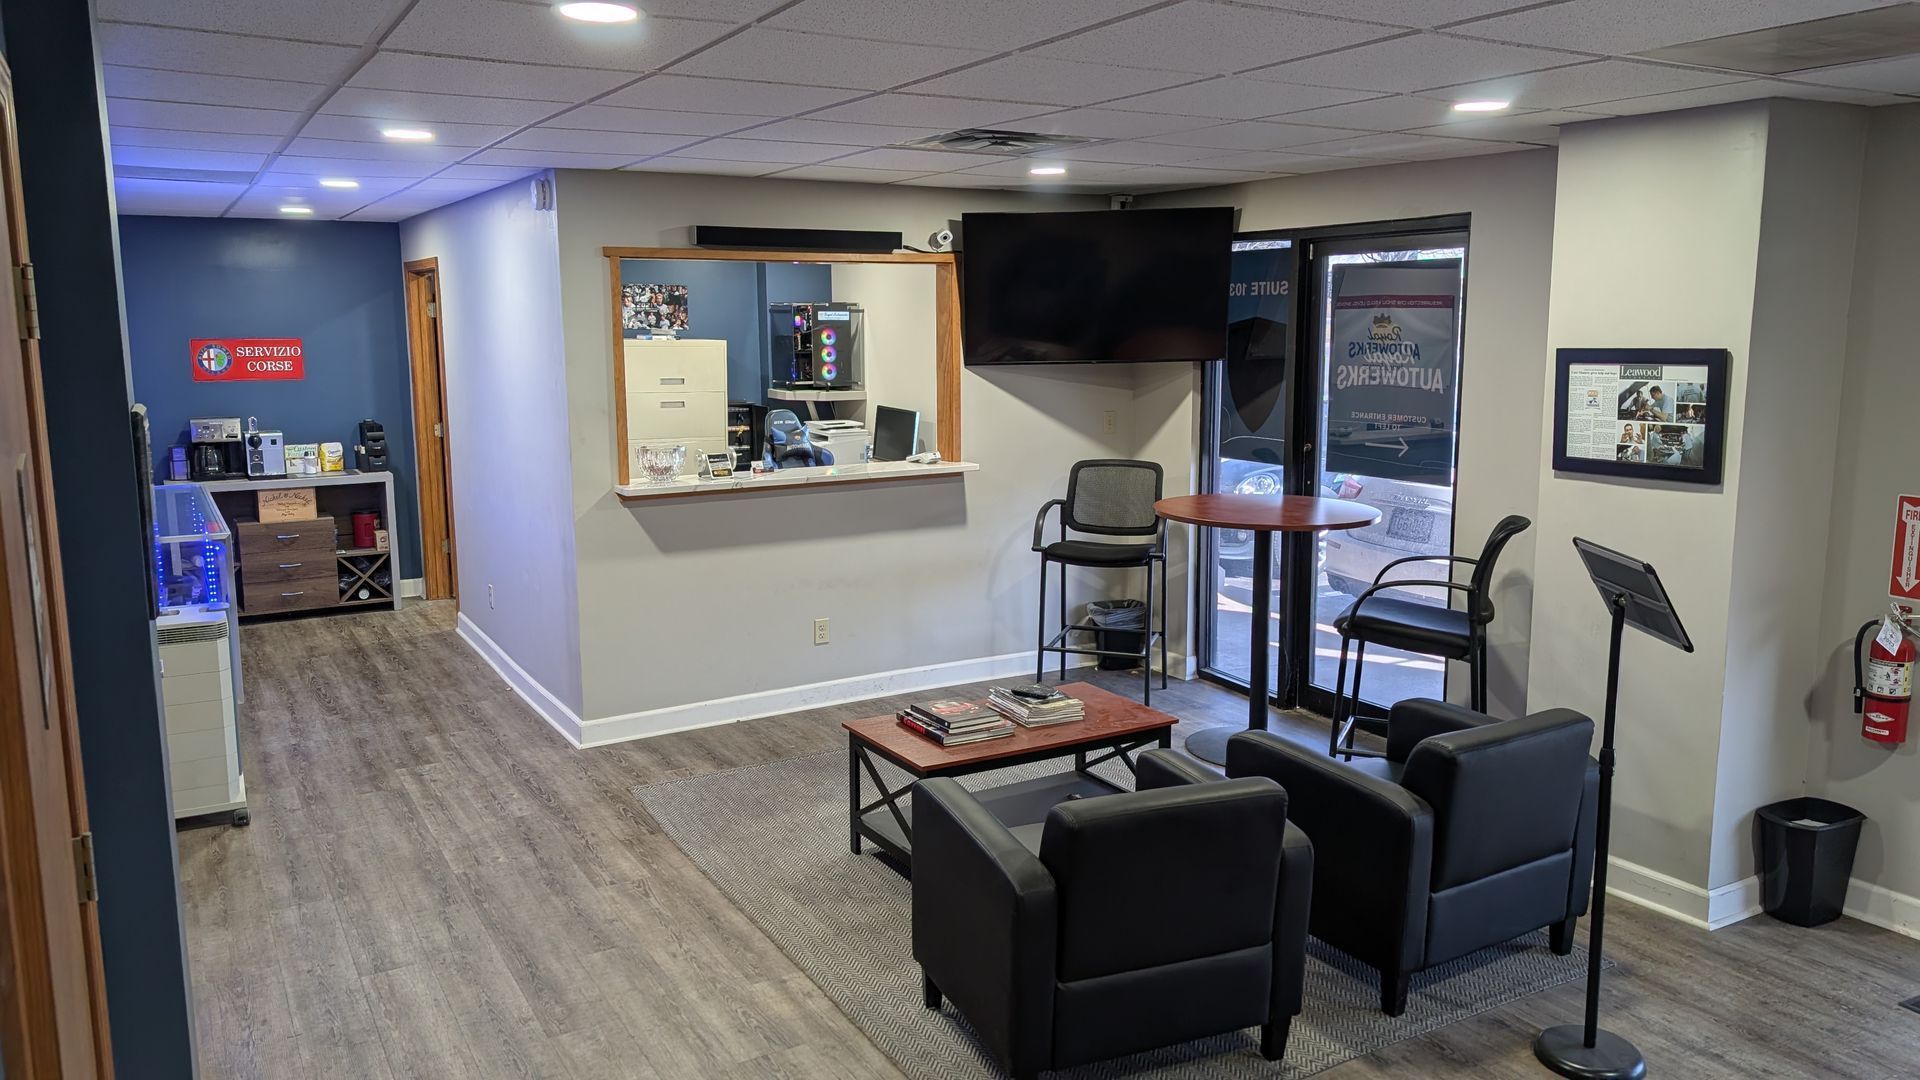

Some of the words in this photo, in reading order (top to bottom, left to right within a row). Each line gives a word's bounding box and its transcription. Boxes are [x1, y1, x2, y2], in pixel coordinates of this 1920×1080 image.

[236, 346, 301, 357] SERVIZIO
[247, 360, 294, 372] CORSE
[1620, 365, 1662, 377] Leawood
[1905, 524, 1916, 588] EXTINGUISHER
